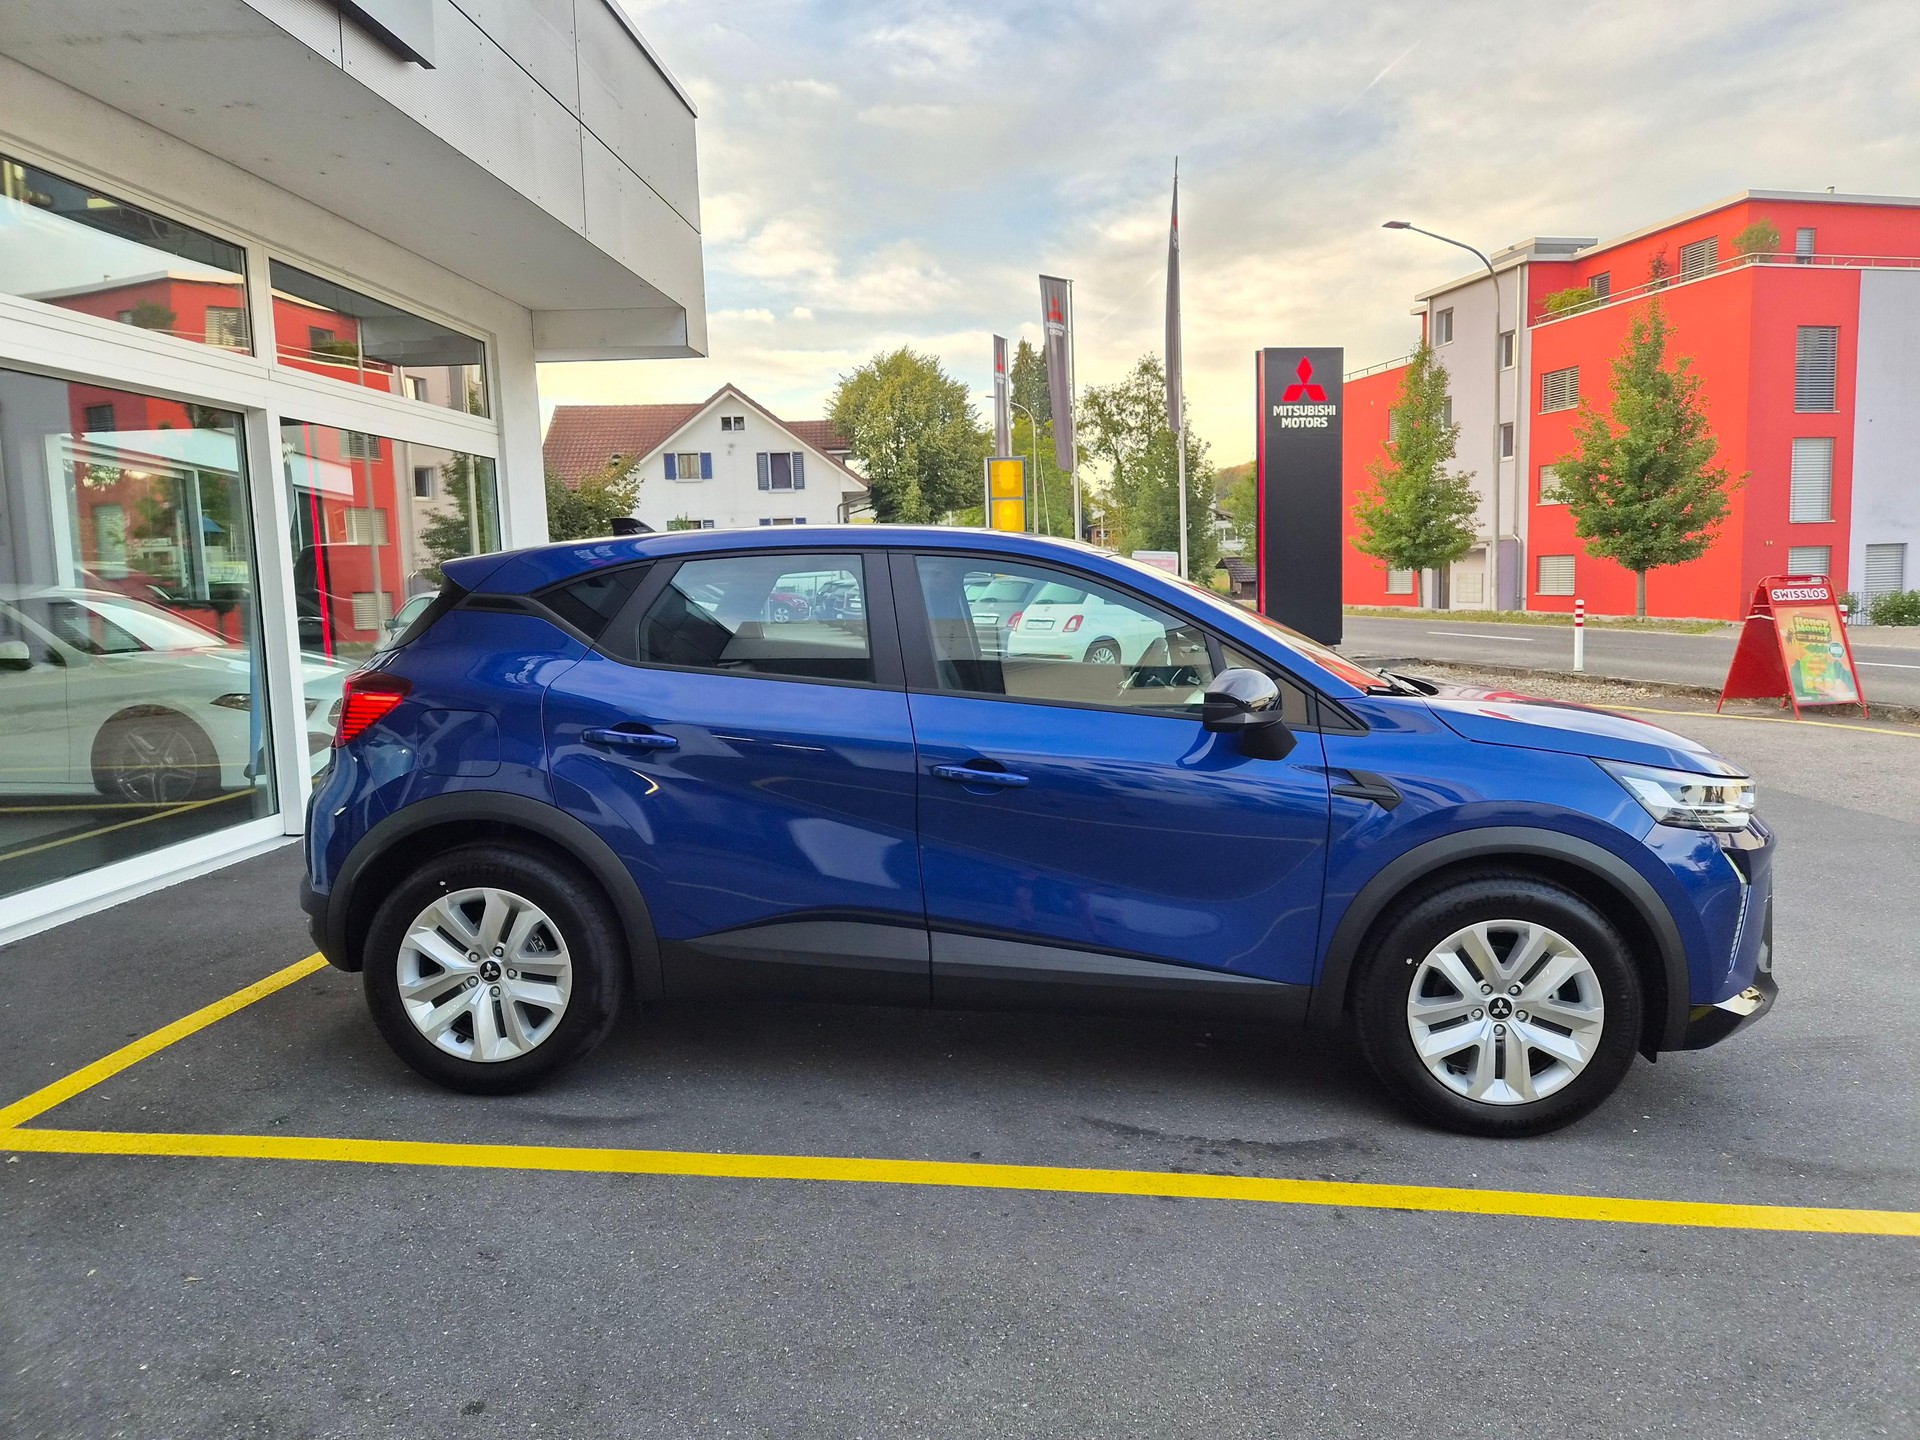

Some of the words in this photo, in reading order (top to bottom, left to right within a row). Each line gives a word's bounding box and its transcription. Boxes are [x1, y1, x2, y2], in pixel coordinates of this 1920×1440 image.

[1273, 405, 1336, 416] MITSUBISHI
[1281, 417, 1328, 428] MOTORS
[1773, 589, 1827, 599] SWISSLOS
[1794, 616, 1829, 628] Honey
[1795, 625, 1830, 636] Money
[1425, 894, 1518, 930] EcoContact
[1525, 894, 1534, 906] 7
